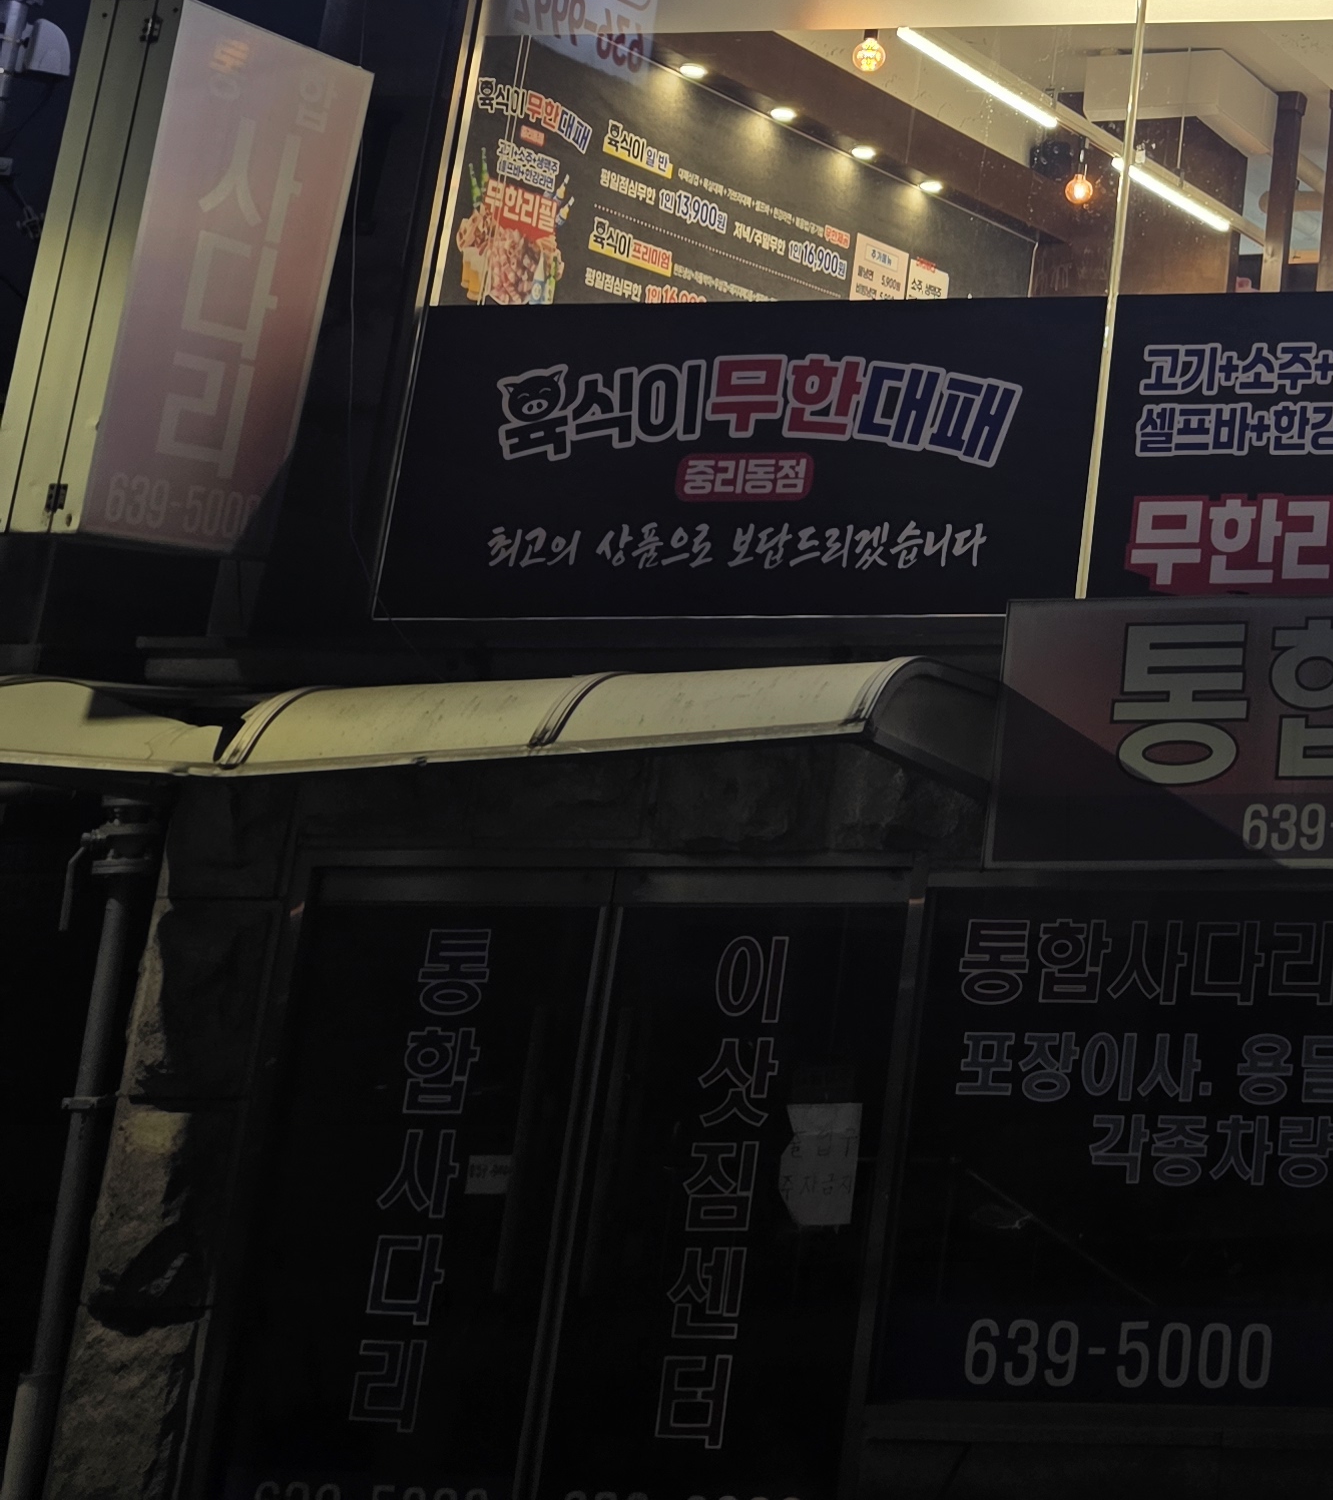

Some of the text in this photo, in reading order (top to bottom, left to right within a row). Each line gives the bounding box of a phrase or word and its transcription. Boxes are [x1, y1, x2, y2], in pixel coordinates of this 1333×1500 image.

[485, 179, 557, 232] 무한리필
[600, 168, 656, 205] 평일점심무한
[683, 459, 807, 495] 중리동점
[486, 520, 988, 572] 최고의 상품으로 보답드리겠습니다
[348, 928, 491, 1433] 통합사다리
[654, 935, 790, 1450] 이삿짐센터
[963, 1317, 1274, 1390] 639-5000
